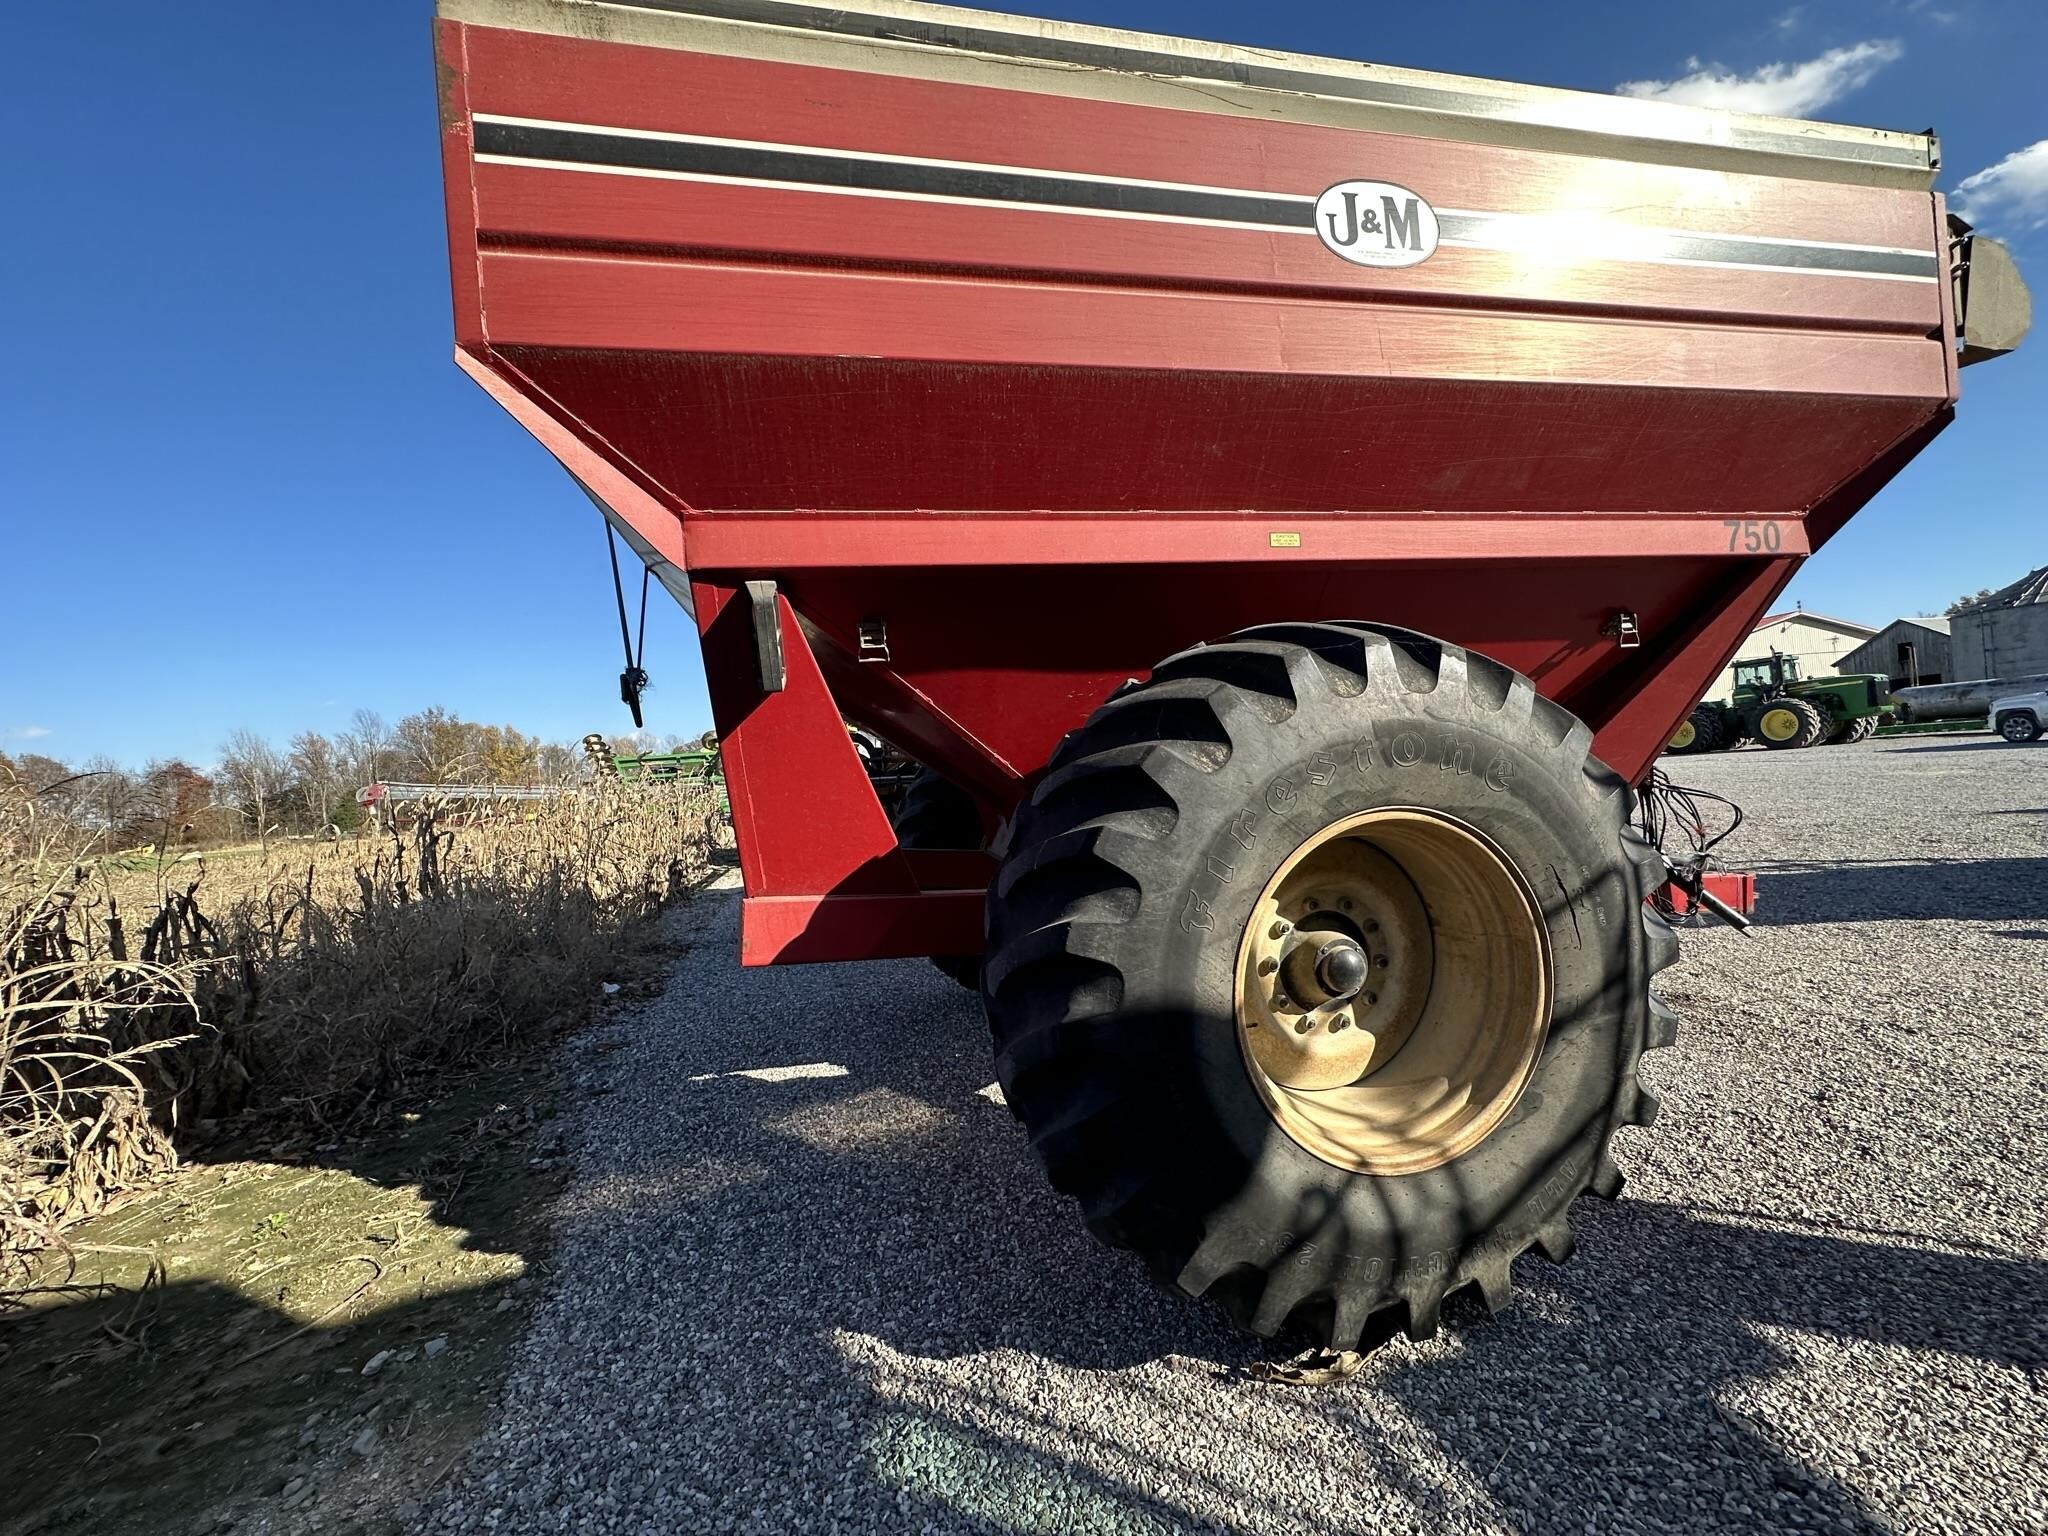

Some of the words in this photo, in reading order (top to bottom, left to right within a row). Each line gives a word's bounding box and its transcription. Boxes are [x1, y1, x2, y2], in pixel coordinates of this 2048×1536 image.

[1325, 191, 1425, 252] J&M
[1723, 519, 1781, 553] 750
[1180, 730, 1516, 935] Firestone
